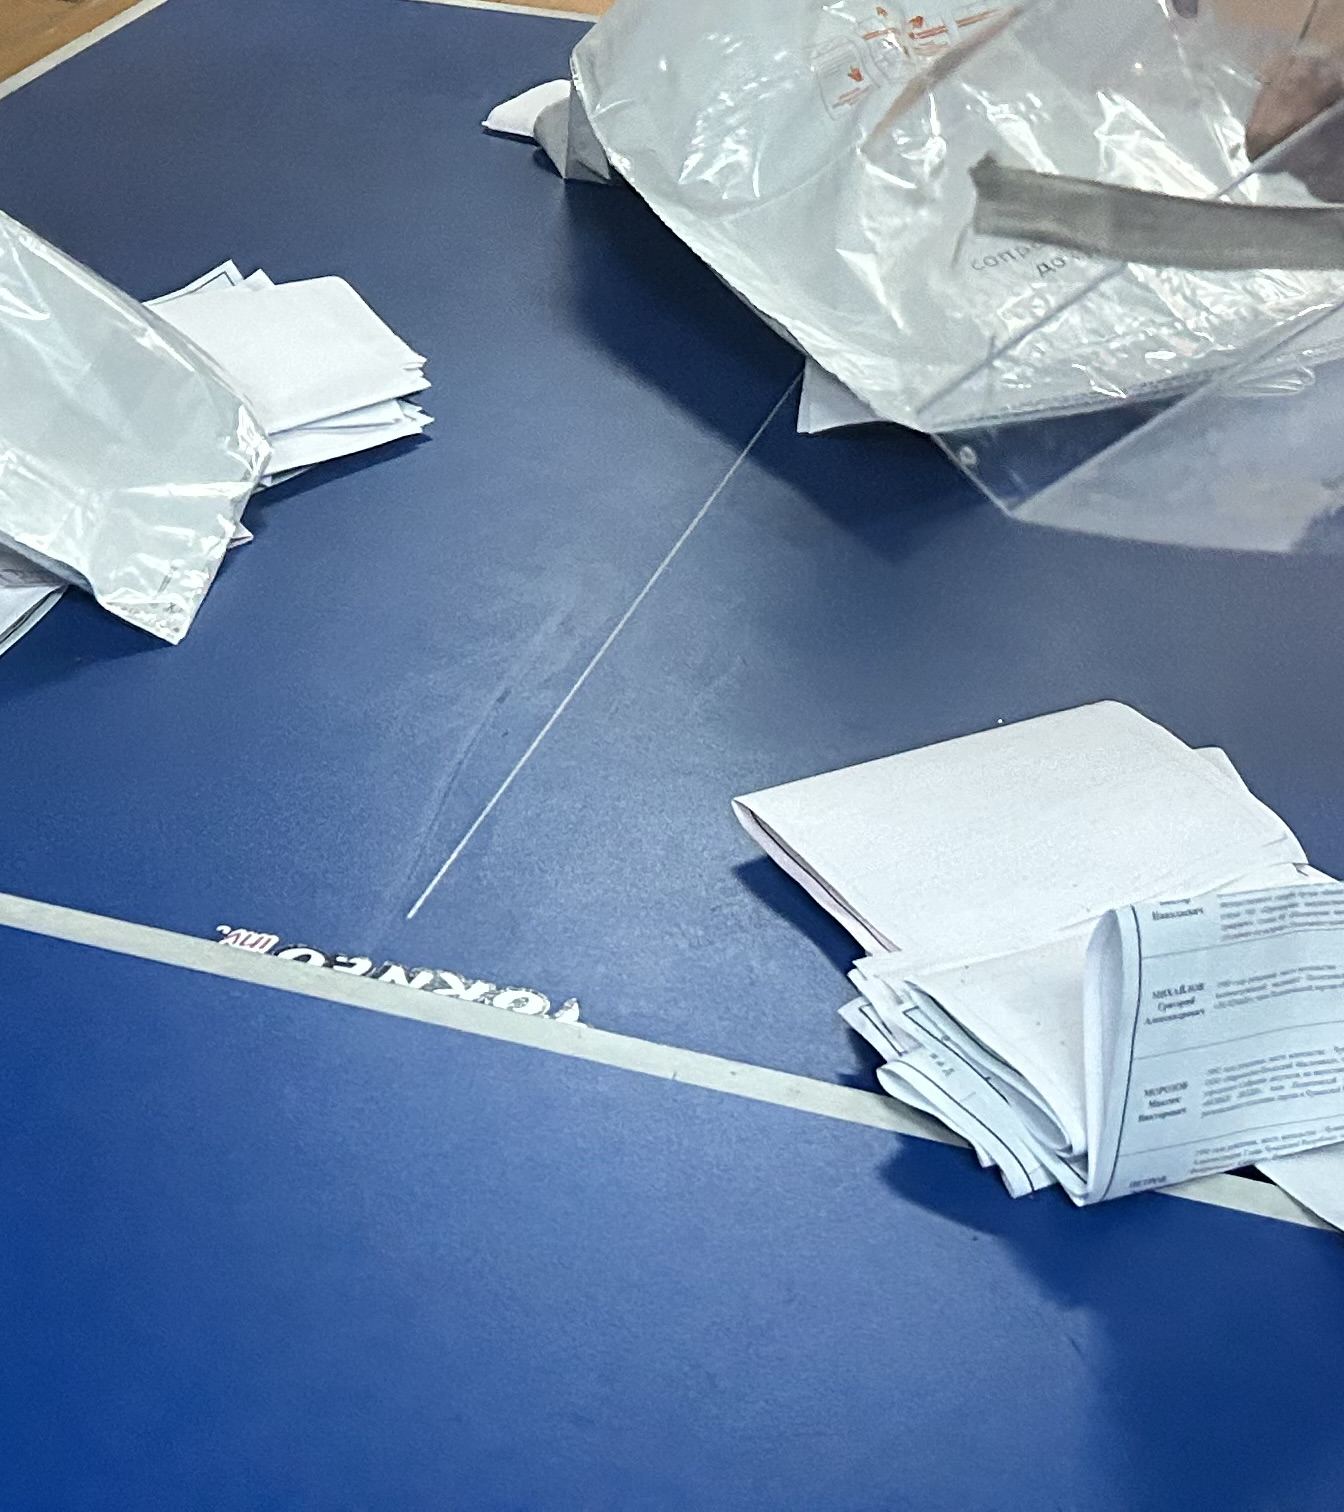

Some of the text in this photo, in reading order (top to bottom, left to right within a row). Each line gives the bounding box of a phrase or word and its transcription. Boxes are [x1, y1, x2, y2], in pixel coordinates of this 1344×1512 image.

[1152, 982, 1204, 999] МИХАЙЛОВ
[1158, 996, 1195, 1012] Григорий
[1144, 1081, 1188, 1097] МОРОЗОВ
[1138, 1107, 1187, 1123] Викторович
